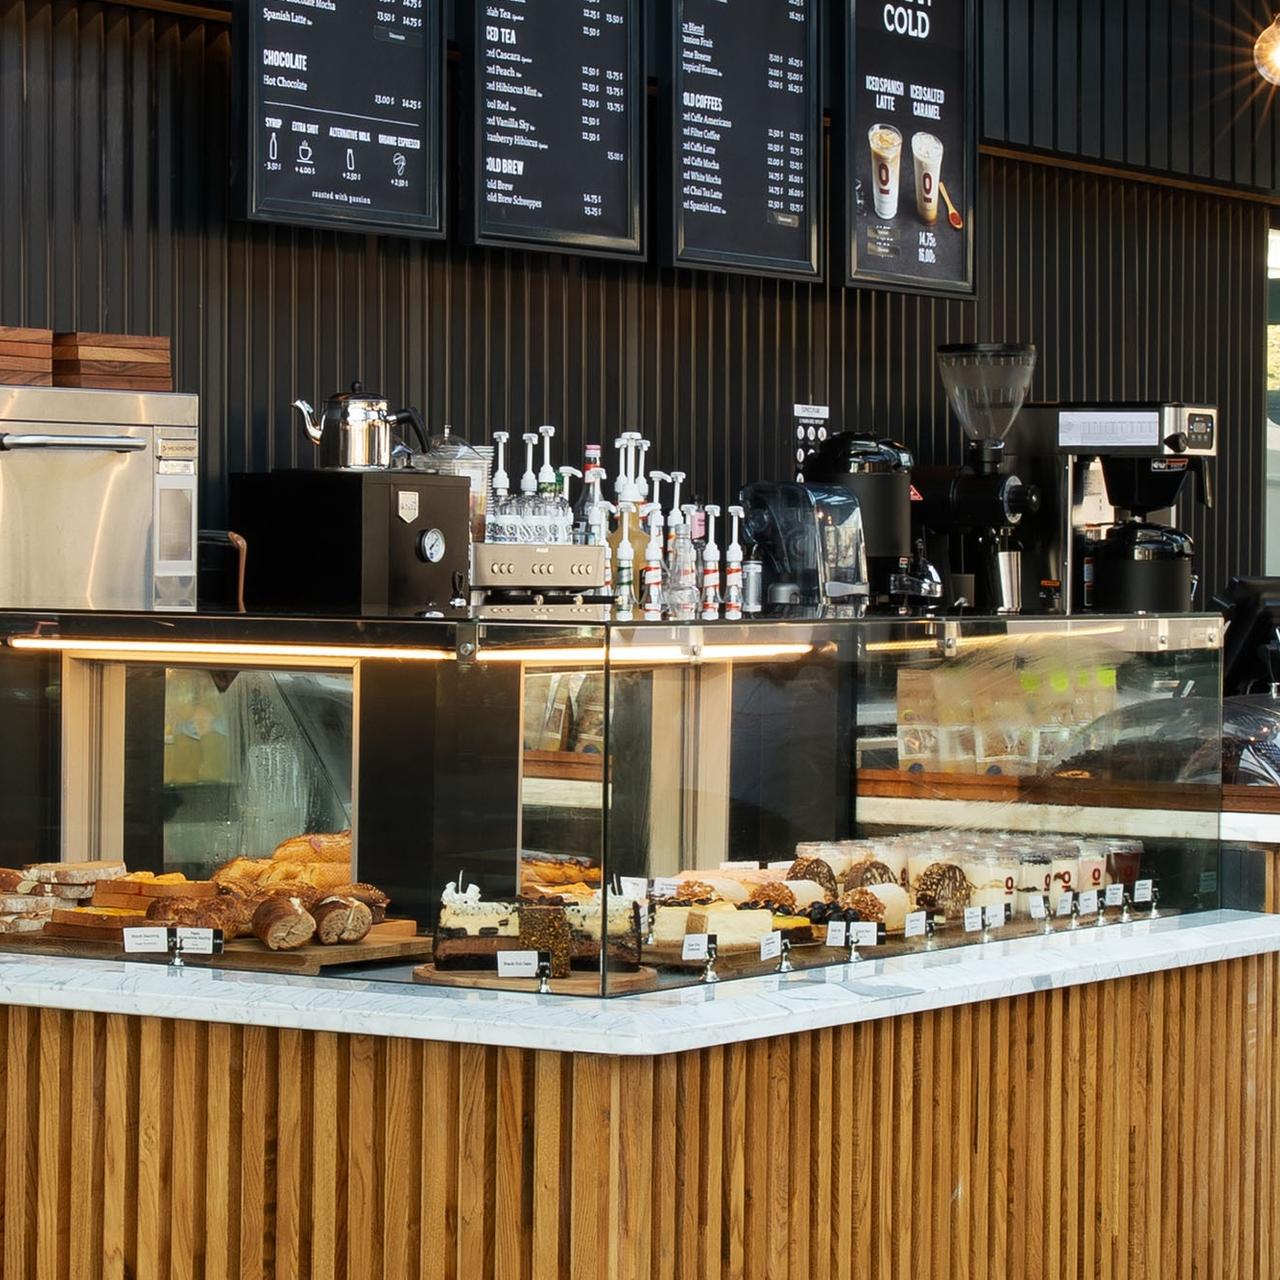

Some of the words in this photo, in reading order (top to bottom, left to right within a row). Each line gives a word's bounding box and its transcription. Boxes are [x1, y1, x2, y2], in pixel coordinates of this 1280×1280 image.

[263, 8, 291, 22] Spanish
[291, 12, 307, 25] Latte
[499, 8, 511, 19] Tea
[883, 4, 930, 39] COLD
[500, 28, 516, 44] TEA
[264, 49, 307, 71] CHOCOLATE
[496, 49, 521, 62] Cascara
[496, 65, 515, 77] Peach
[264, 75, 276, 86] Hot
[277, 76, 307, 91] Chocolate
[496, 81, 523, 94] Hibiscus
[524, 85, 538, 97] Mint
[865, 75, 879, 92] ICED
[879, 77, 904, 96] SPANISH
[910, 84, 923, 100] ICED
[923, 86, 945, 104] SALTED
[497, 100, 509, 111] Red
[695, 94, 722, 111] COFFEES
[876, 94, 895, 111] LATTE
[913, 101, 941, 120] CARAMEL
[496, 116, 518, 128] Vanilla
[519, 119, 530, 132] Sky
[514, 135, 538, 148] Hibiscus
[703, 129, 720, 141] Coffee
[502, 159, 524, 175] BREW
[497, 180, 513, 191] Brew
[335, 193, 348, 201] with
[498, 193, 513, 204] Brew
[513, 195, 542, 210] Schweppes
